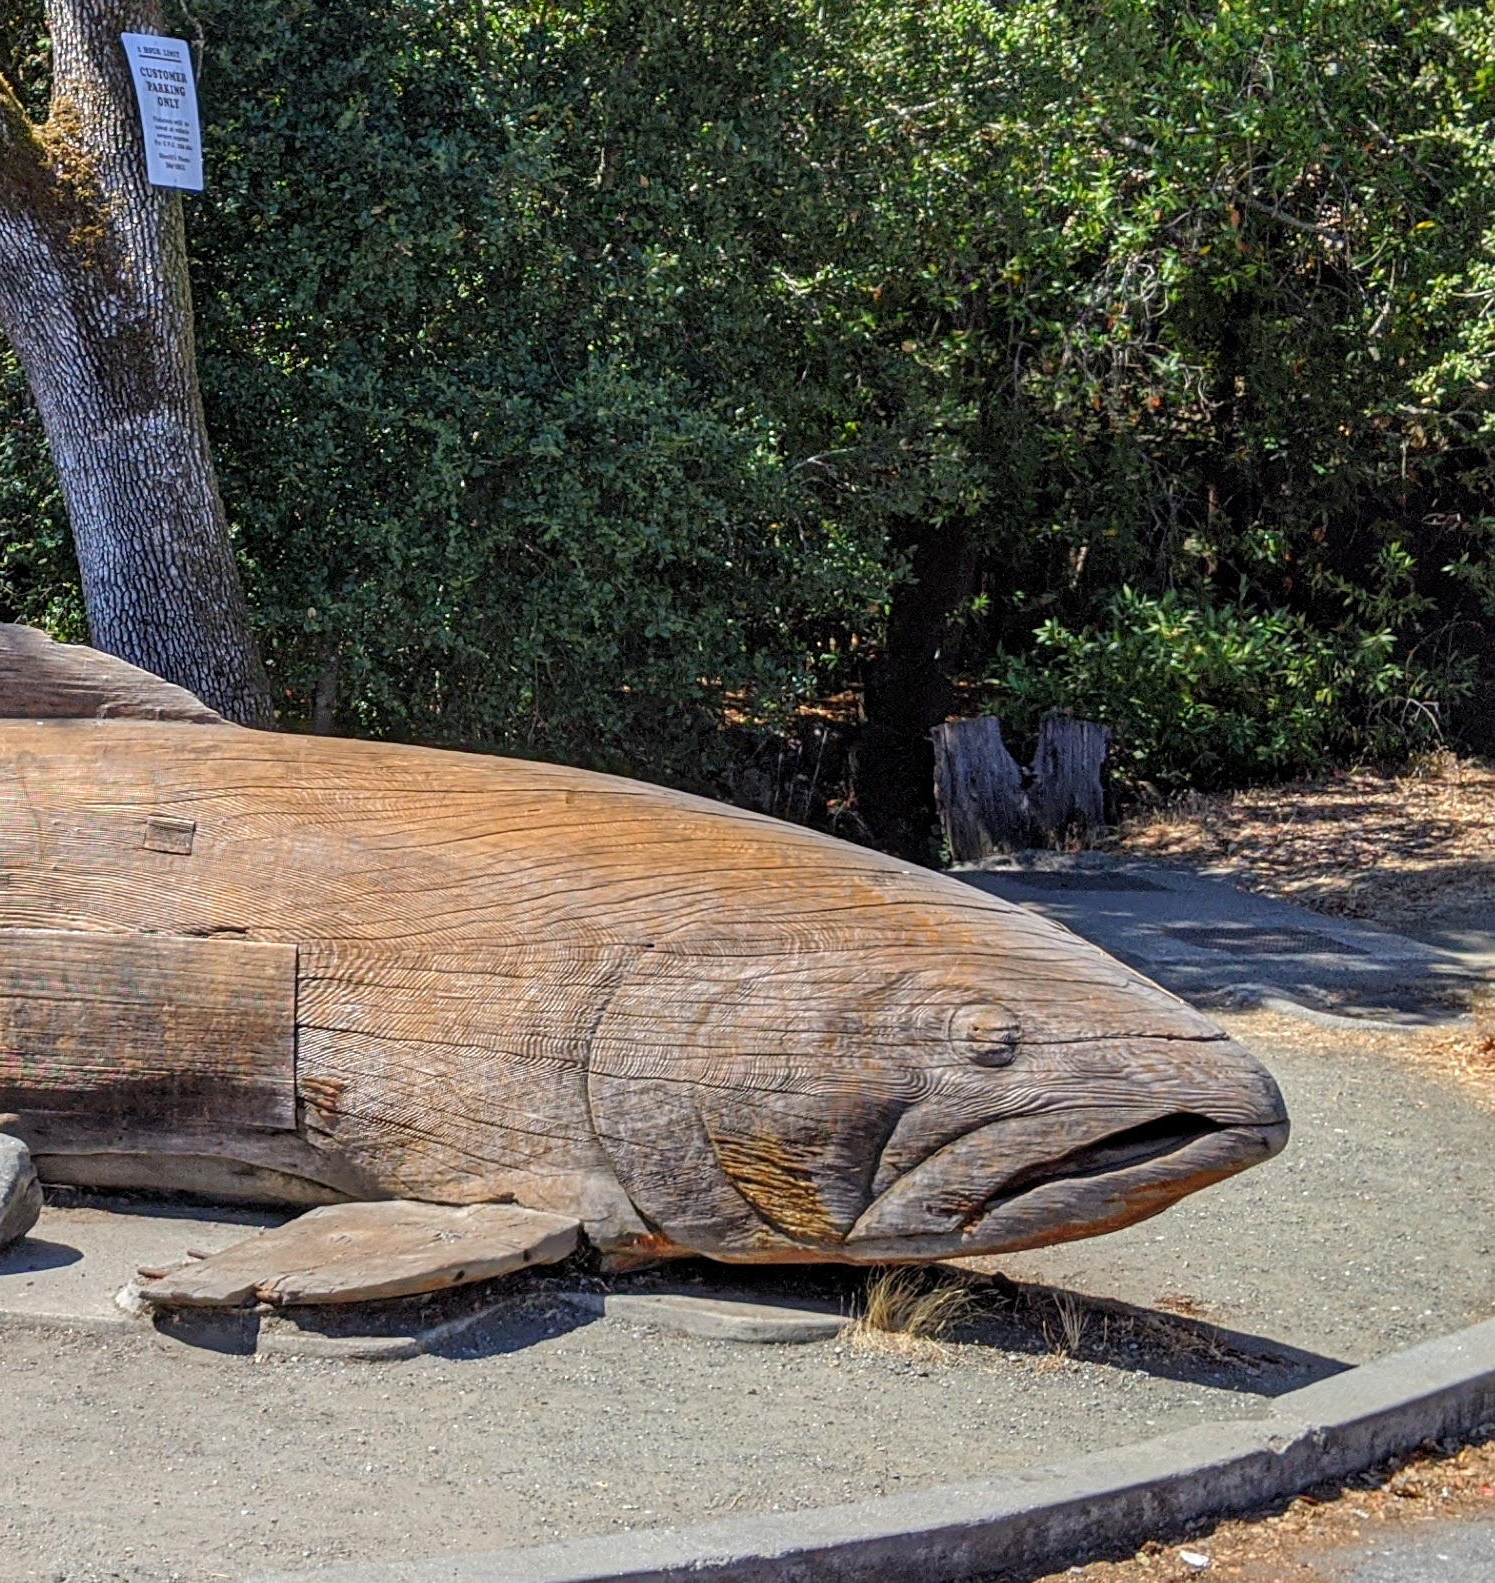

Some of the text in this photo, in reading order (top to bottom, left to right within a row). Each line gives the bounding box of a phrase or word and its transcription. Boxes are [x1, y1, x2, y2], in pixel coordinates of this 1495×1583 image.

[143, 46, 161, 55] HOUR
[163, 49, 180, 58] LIMIT
[139, 66, 188, 83] CUSTOMER
[146, 81, 186, 97] PARKING
[157, 96, 180, 109] ONLY
